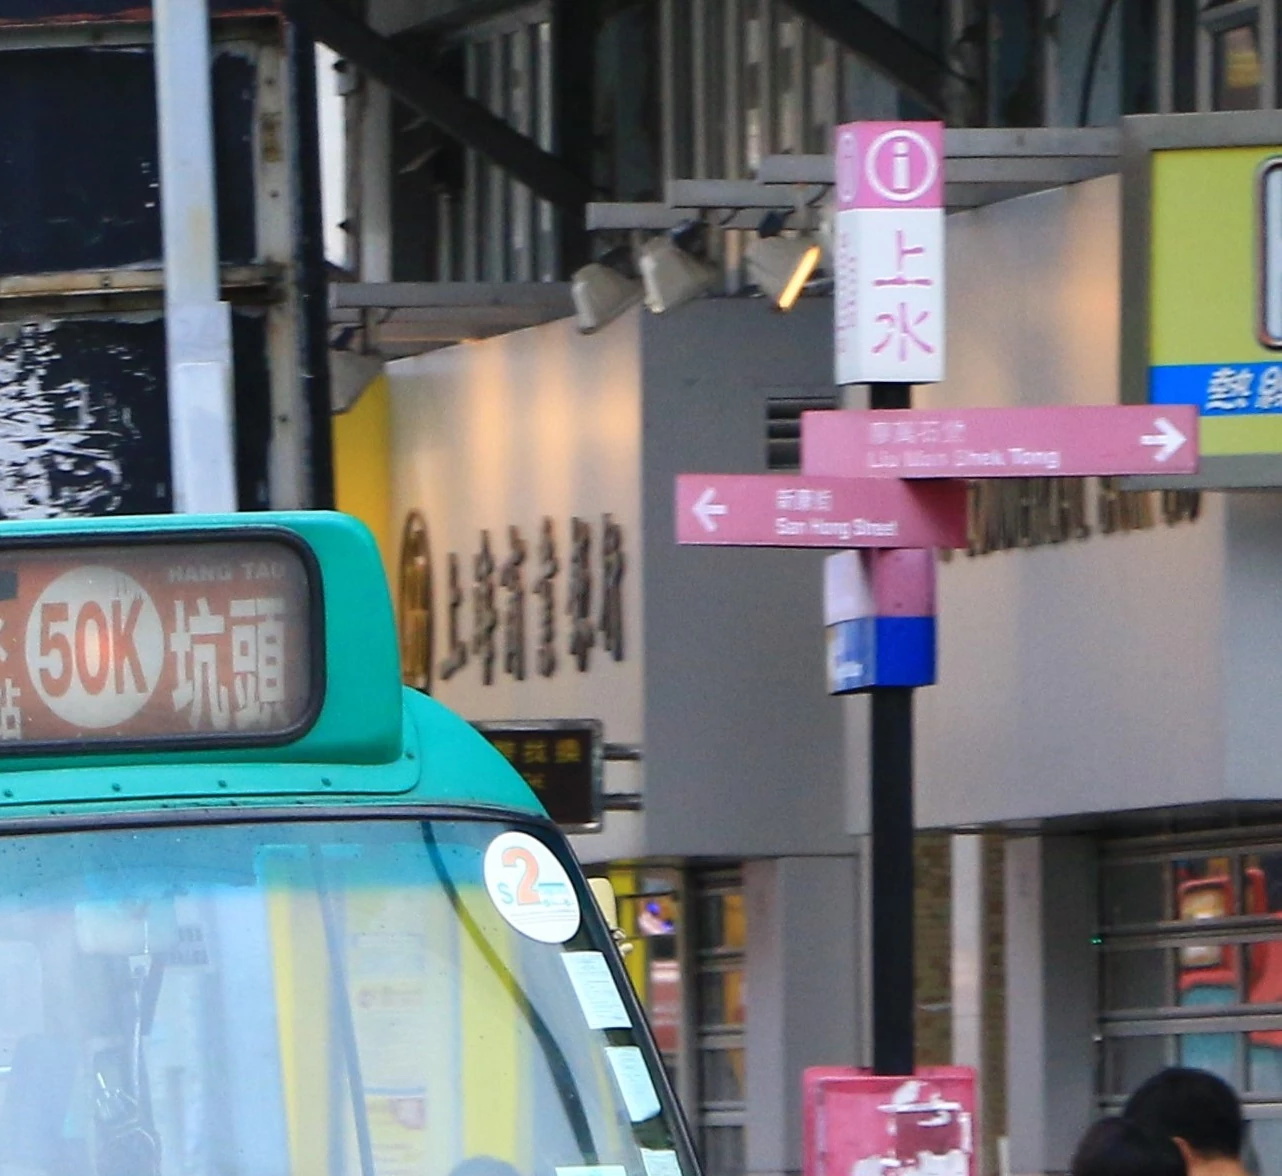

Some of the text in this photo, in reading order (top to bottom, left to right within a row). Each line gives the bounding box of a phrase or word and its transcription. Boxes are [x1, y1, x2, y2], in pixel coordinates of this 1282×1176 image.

[871, 230, 934, 362] 上水
[1007, 447, 1062, 470] Tong
[852, 518, 899, 536] Street
[38, 600, 149, 698] 50K
[171, 597, 288, 732] 坑頭
